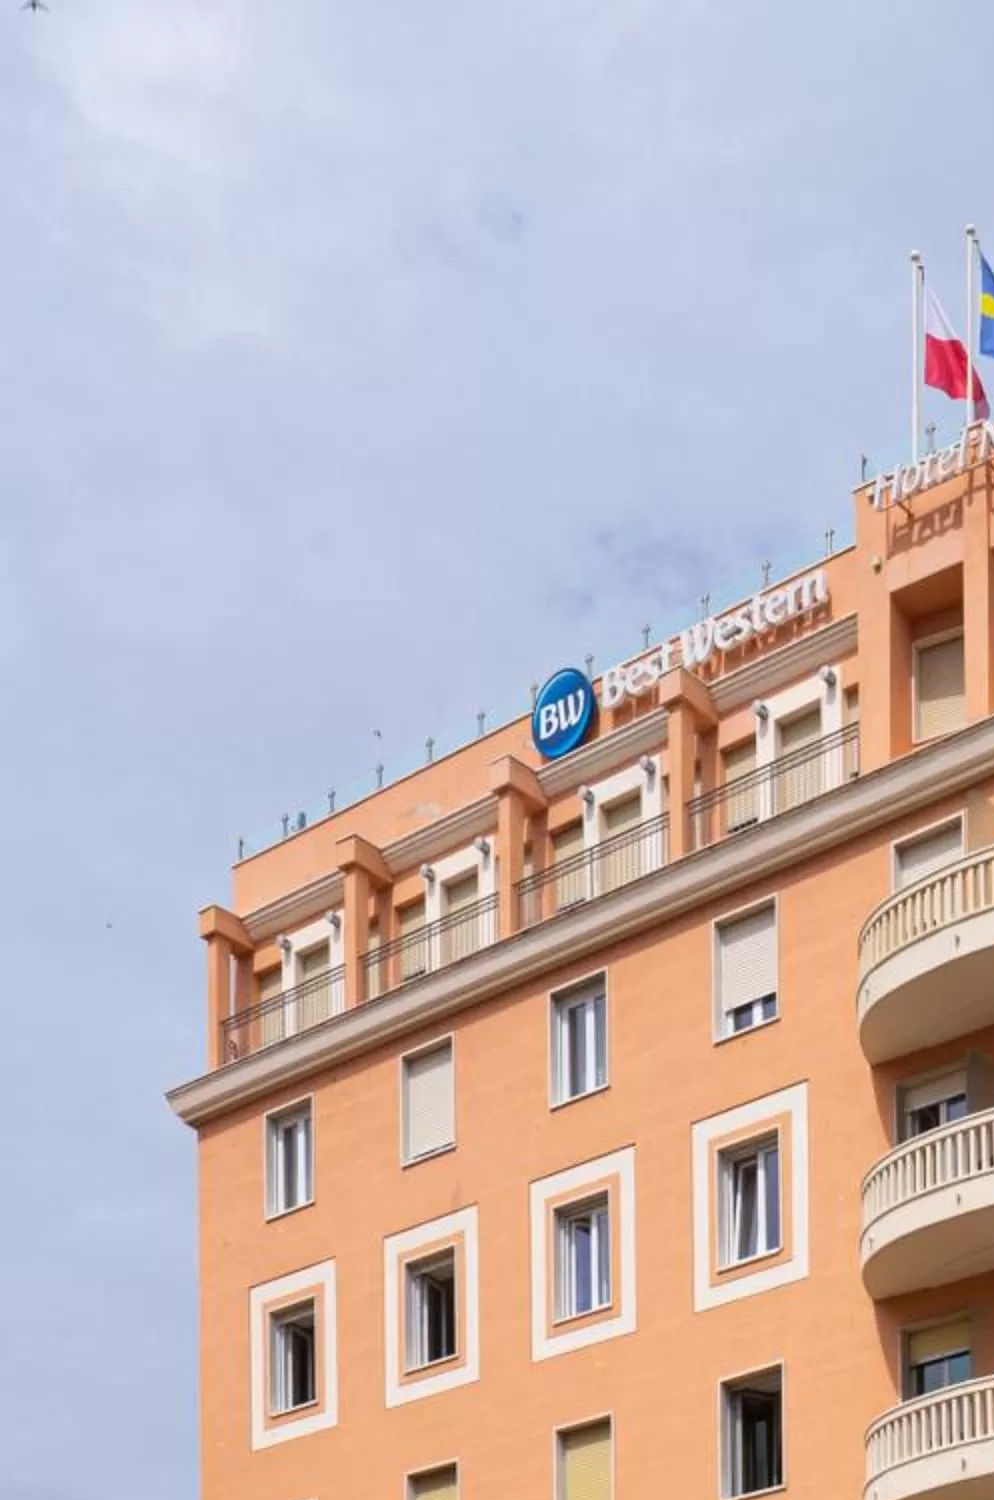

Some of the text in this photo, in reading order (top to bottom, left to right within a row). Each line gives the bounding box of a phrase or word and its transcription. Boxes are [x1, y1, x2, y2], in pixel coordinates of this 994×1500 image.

[873, 426, 969, 512] Hotel
[539, 569, 827, 740] BW Best Western
